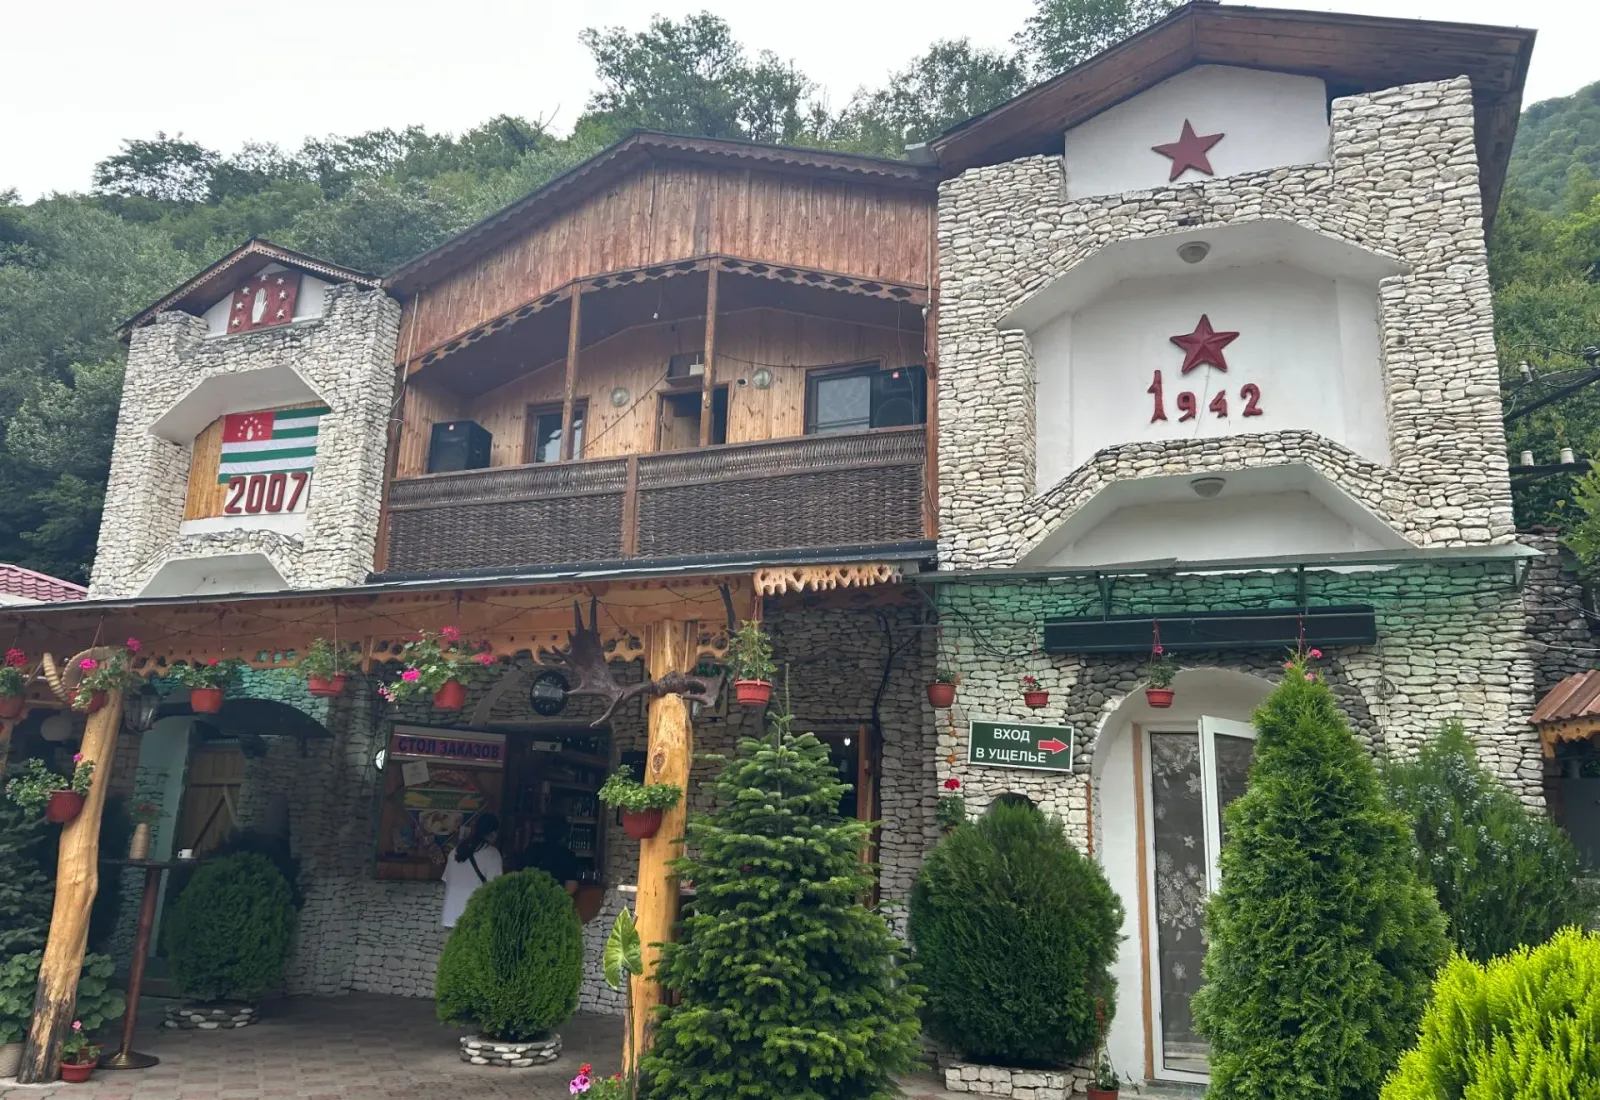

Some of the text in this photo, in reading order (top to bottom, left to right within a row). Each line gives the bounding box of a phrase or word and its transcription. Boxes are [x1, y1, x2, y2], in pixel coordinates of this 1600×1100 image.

[1147, 369, 1263, 424] 1942
[224, 471, 309, 514] 2007
[993, 727, 1031, 744] ВХОД
[398, 736, 500, 759] СТОЛ ЗАКАЗОВ
[975, 747, 1047, 764] В УЩЕЛЬЕ
